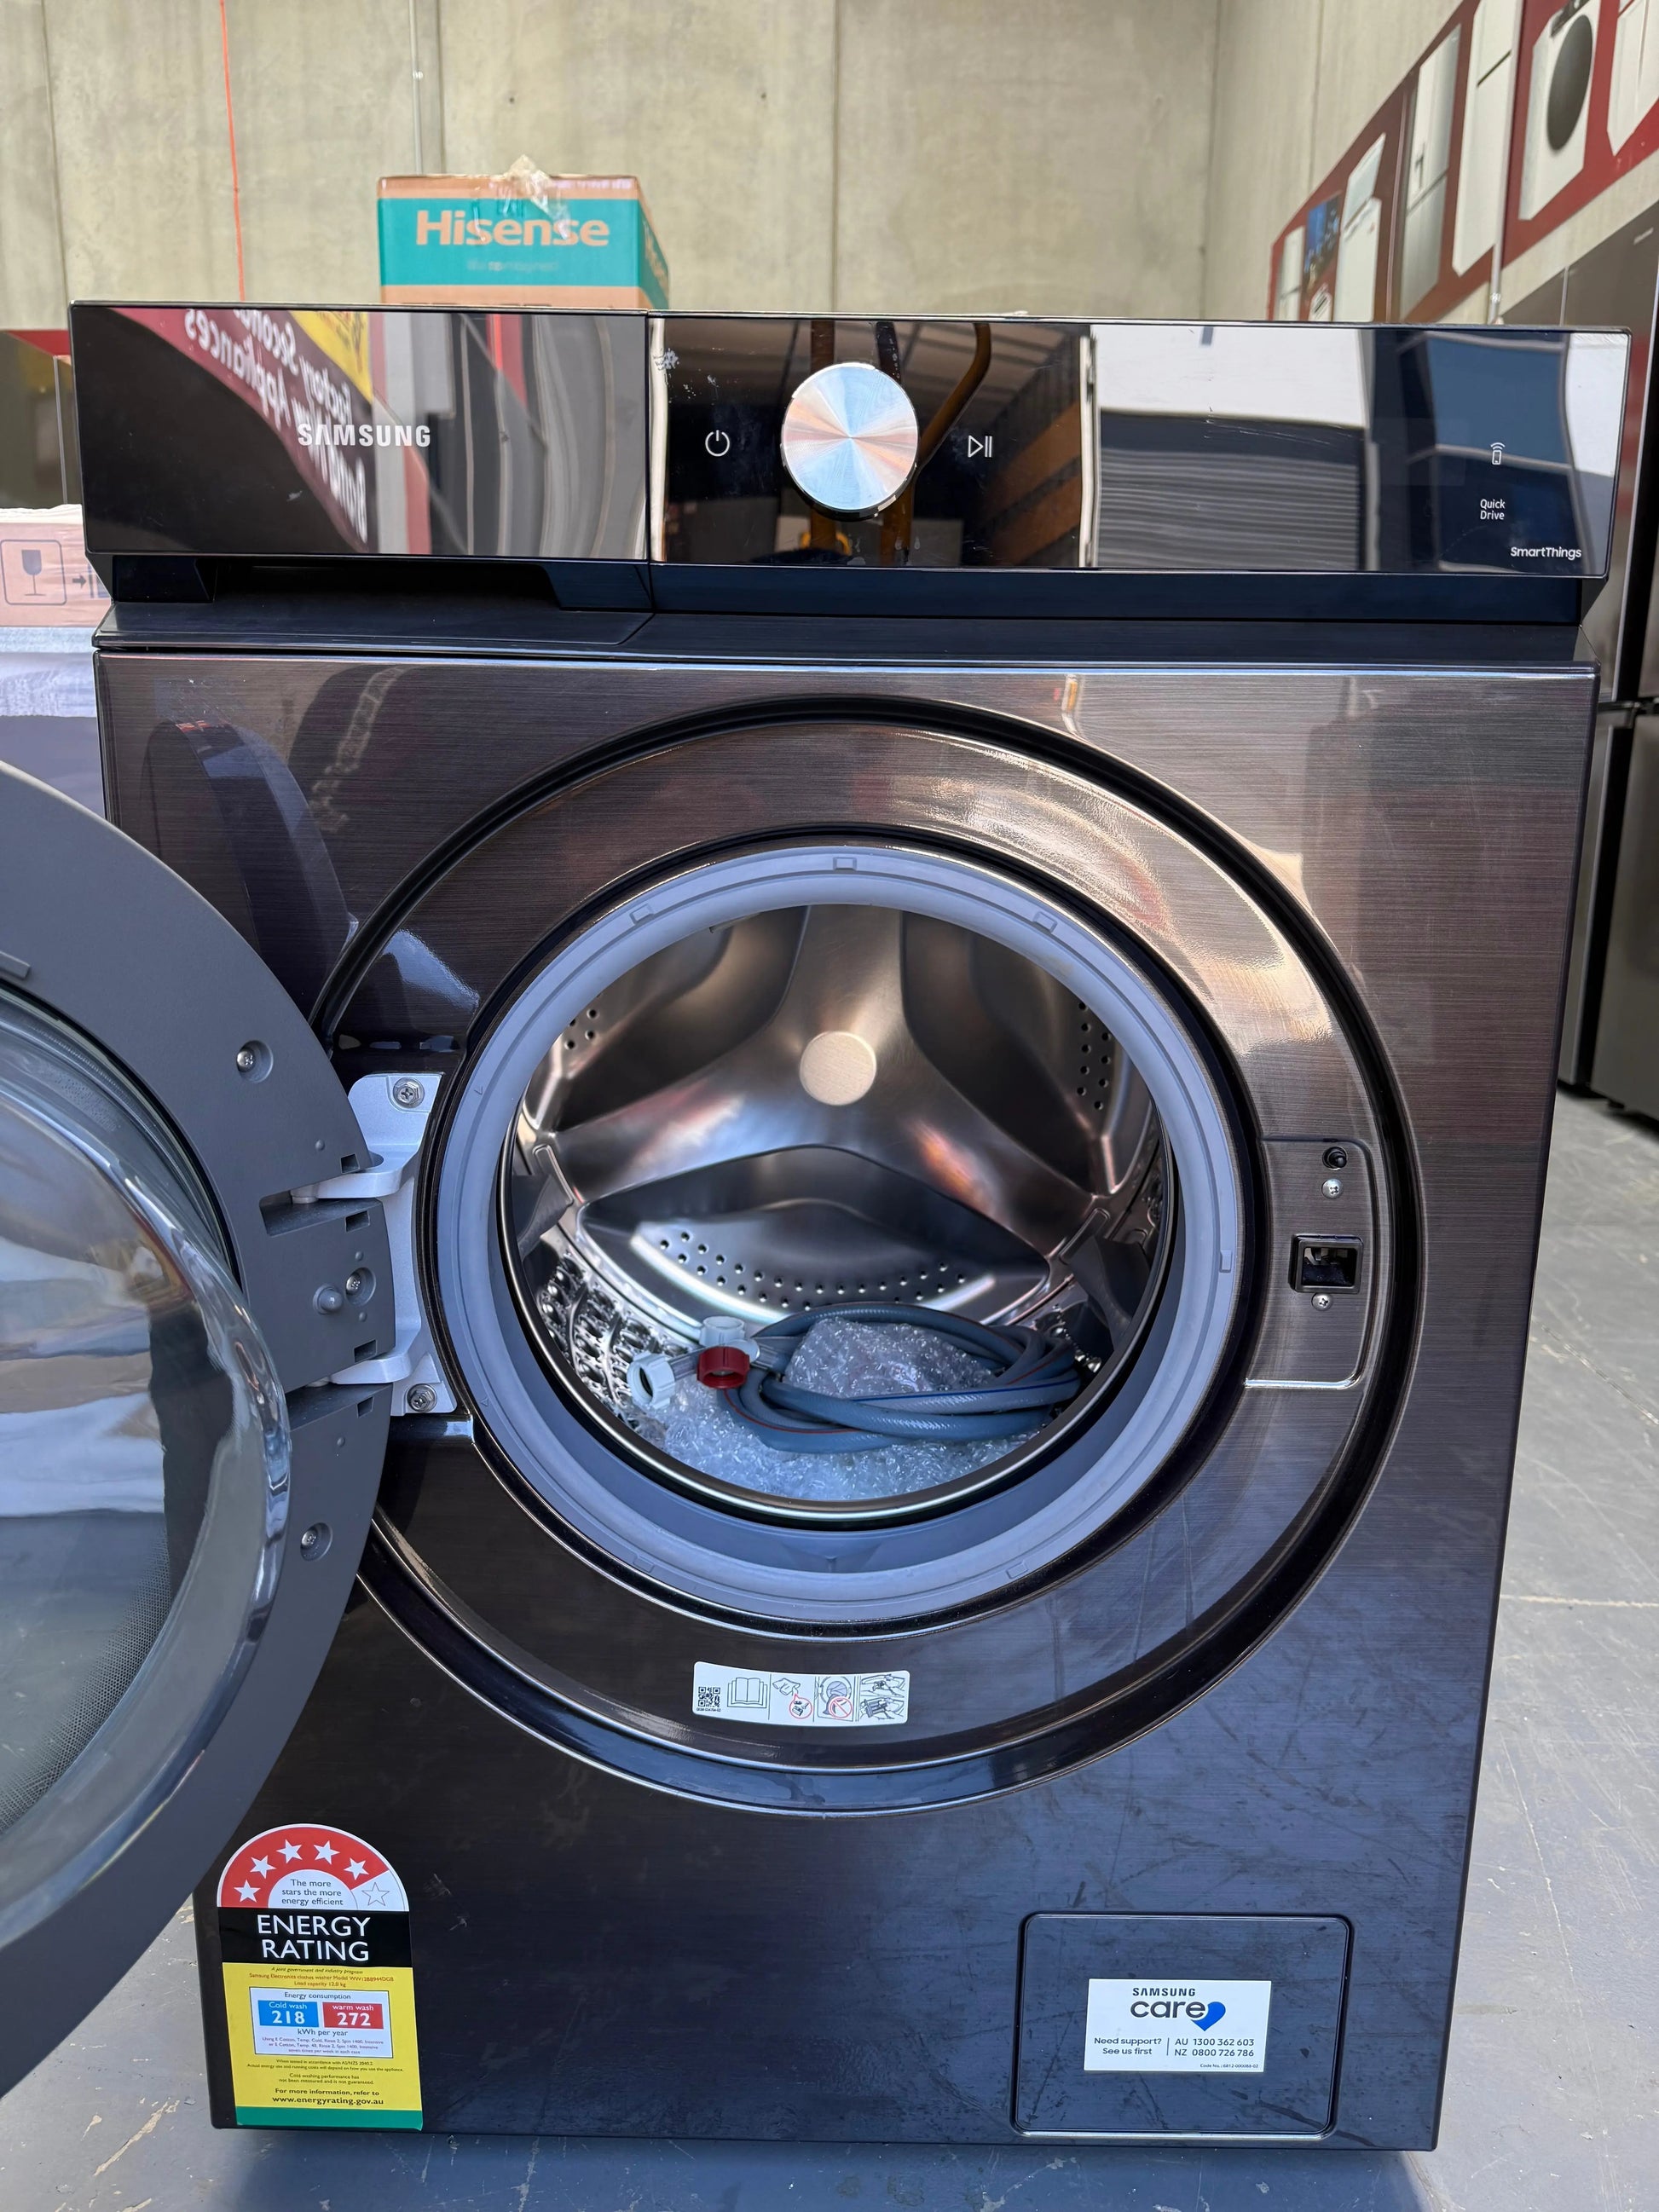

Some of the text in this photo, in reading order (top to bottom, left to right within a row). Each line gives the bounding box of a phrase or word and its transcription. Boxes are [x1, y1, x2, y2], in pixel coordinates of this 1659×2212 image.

[416, 210, 610, 247] Hisense
[298, 424, 431, 448] SAMSUNG
[1480, 499, 1506, 510] Quick
[1480, 511, 1506, 521] Drive
[1511, 546, 1582, 561] SmartThings
[291, 1879, 307, 1887] The
[281, 1897, 344, 1907] energy efficient
[257, 1915, 371, 1938] ENERGY
[262, 1939, 369, 1961] RATING
[1132, 1987, 1196, 1996] SAMSUNG
[1130, 2001, 1206, 2019] care
[272, 2010, 305, 2024] 218
[337, 2012, 371, 2026] 272
[1120, 2037, 1162, 2046] support?
[1217, 2038, 1234, 2047] 362
[1236, 2038, 1255, 2047] 603
[272, 2097, 384, 2105] www.energyrating.gov.au
